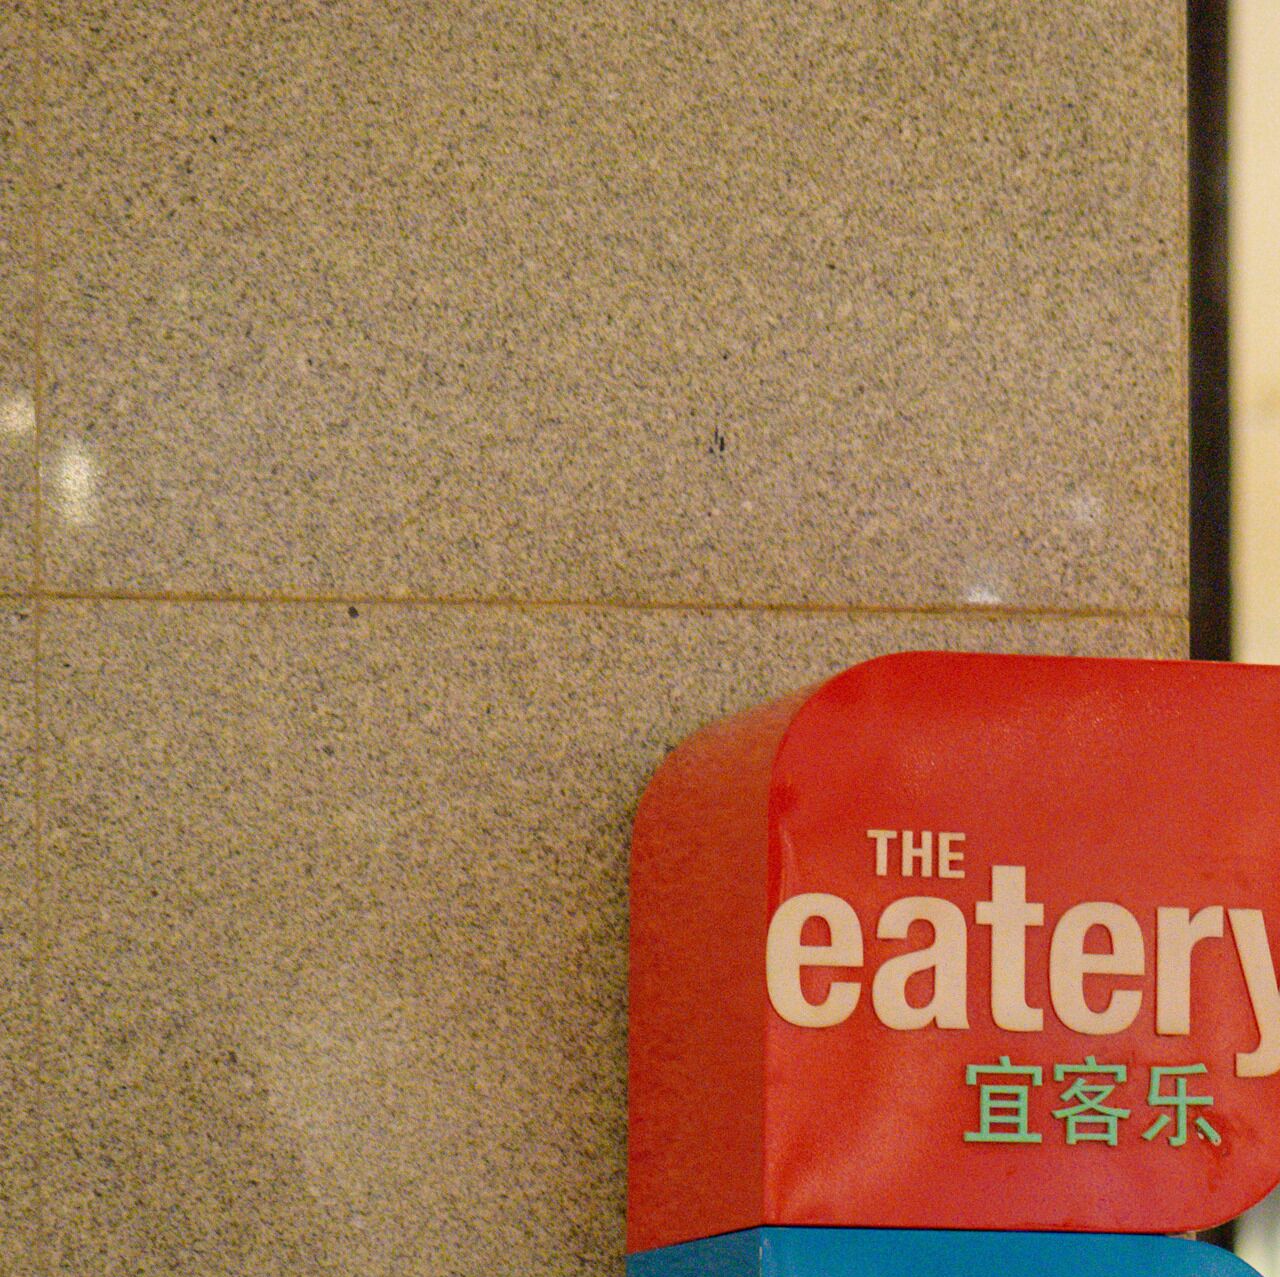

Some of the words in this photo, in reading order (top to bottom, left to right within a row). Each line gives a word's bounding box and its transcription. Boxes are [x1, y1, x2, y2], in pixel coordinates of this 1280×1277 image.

[868, 830, 966, 878] THE
[964, 1056, 1221, 1146] 宜客乐
